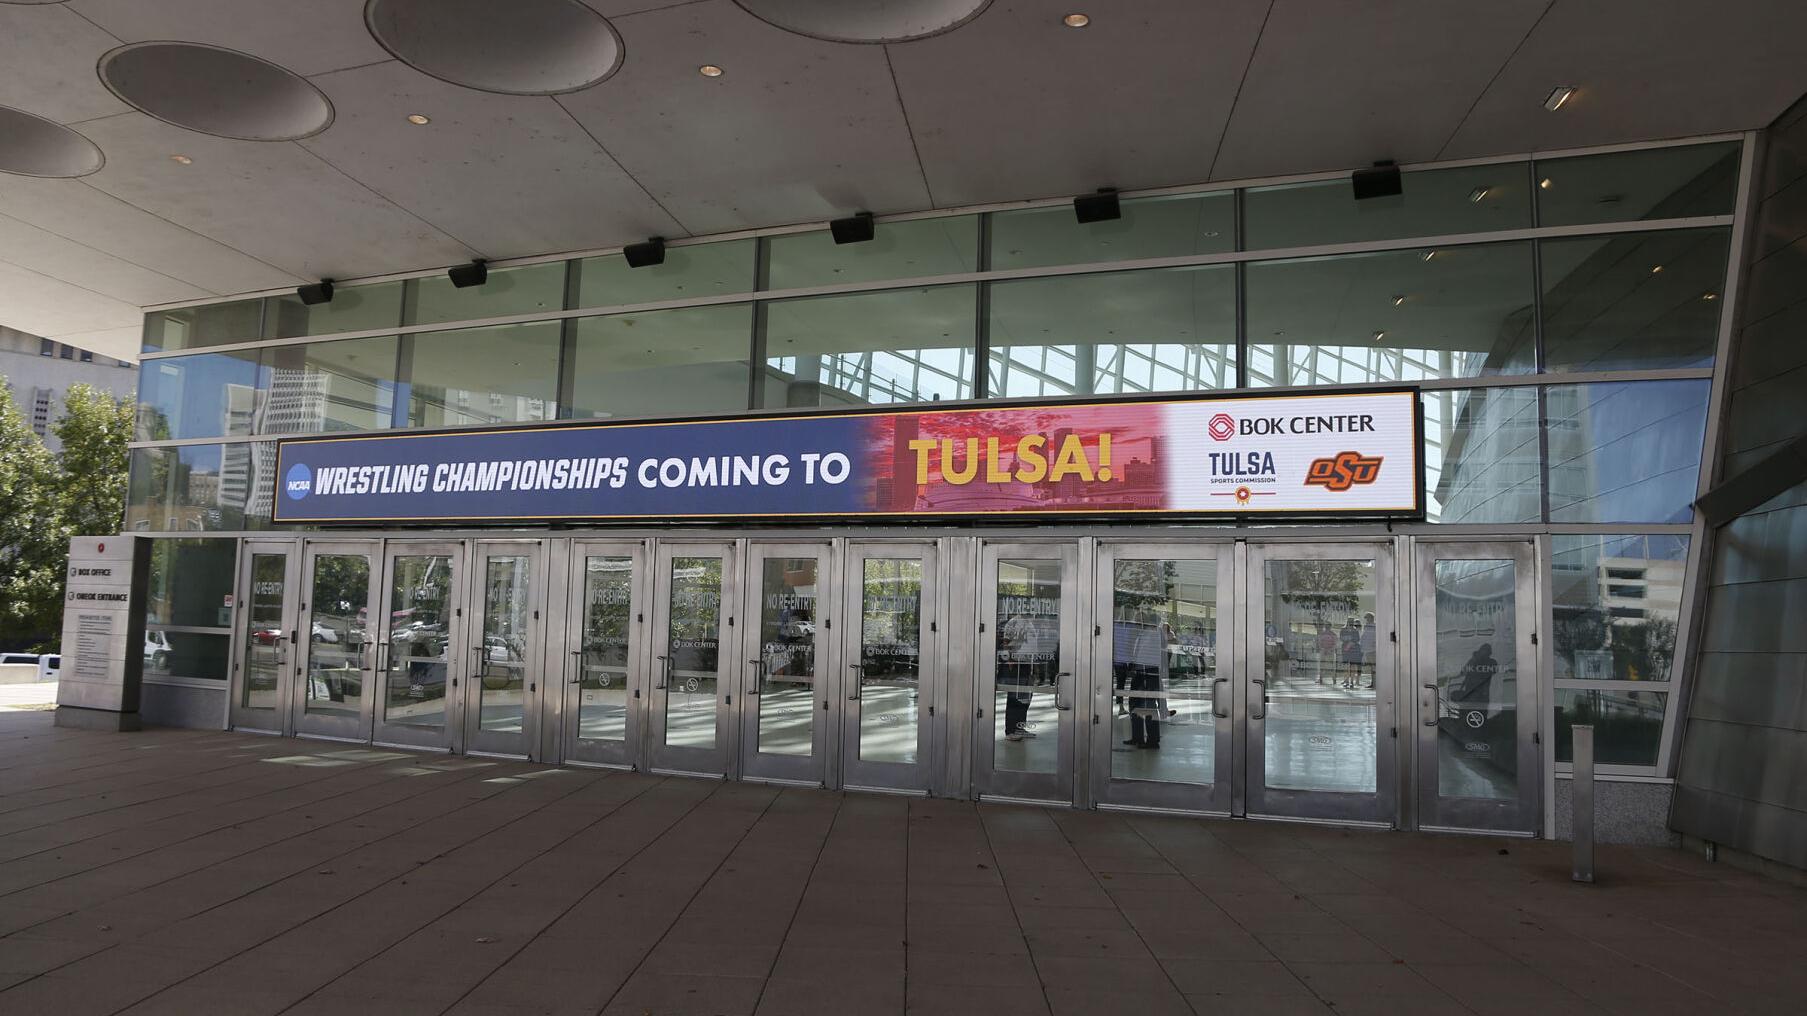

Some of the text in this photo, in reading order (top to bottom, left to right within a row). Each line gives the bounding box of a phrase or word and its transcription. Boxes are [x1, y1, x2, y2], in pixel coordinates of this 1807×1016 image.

[1239, 414, 1376, 436] BOK CENTER
[288, 433, 1113, 495] NCAA WRESTLING CHAMPIONSHIPS COMING TO TULSA!
[1208, 451, 1276, 476] TULSA
[1304, 451, 1384, 491] OSU
[79, 568, 113, 577] BOX OFFICE
[97, 593, 128, 602] ENTRANCE
[766, 593, 777, 609] NO
[1002, 597, 1057, 615] NO RE-ENTRY
[695, 641, 717, 649] CENTER
